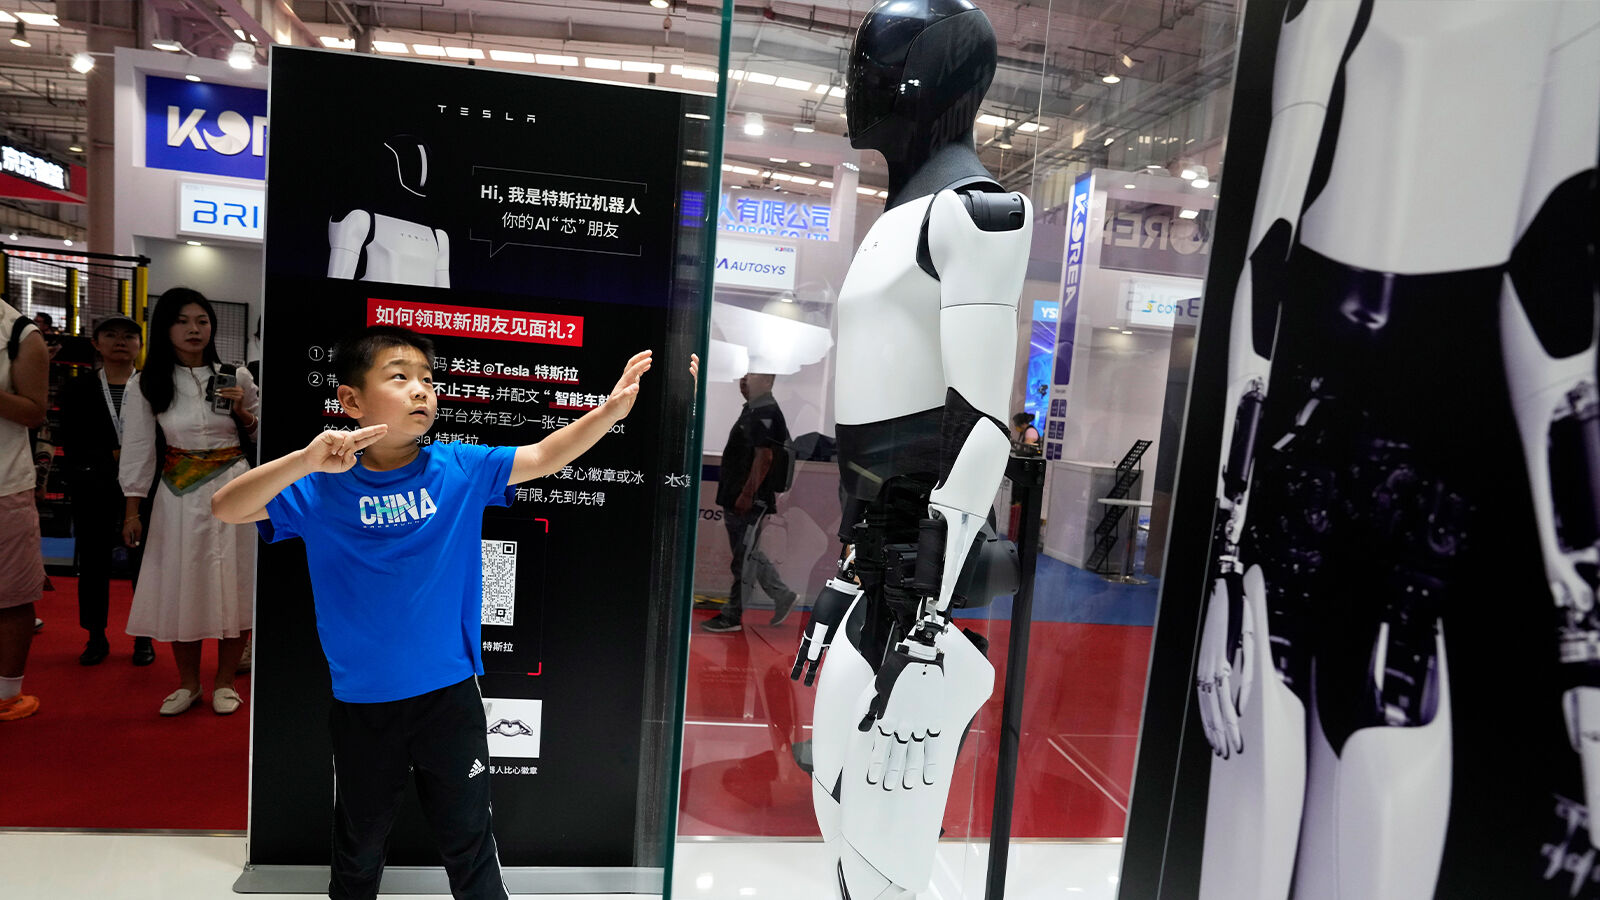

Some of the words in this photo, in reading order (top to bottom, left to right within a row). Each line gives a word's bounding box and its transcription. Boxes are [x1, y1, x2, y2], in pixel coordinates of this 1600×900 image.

[437, 104, 536, 123] TESLA
[480, 184, 504, 204] Hi,
[508, 186, 641, 215] 我是特斯拉机器人
[193, 199, 258, 229] BRI
[1065, 192, 1087, 307] KOREA
[730, 261, 786, 275] AUTOSYS
[483, 363, 530, 377] @Tesla
[535, 364, 579, 382] 特斯拉
[359, 487, 437, 525] CHINA
[482, 641, 514, 652] 特斯拉
